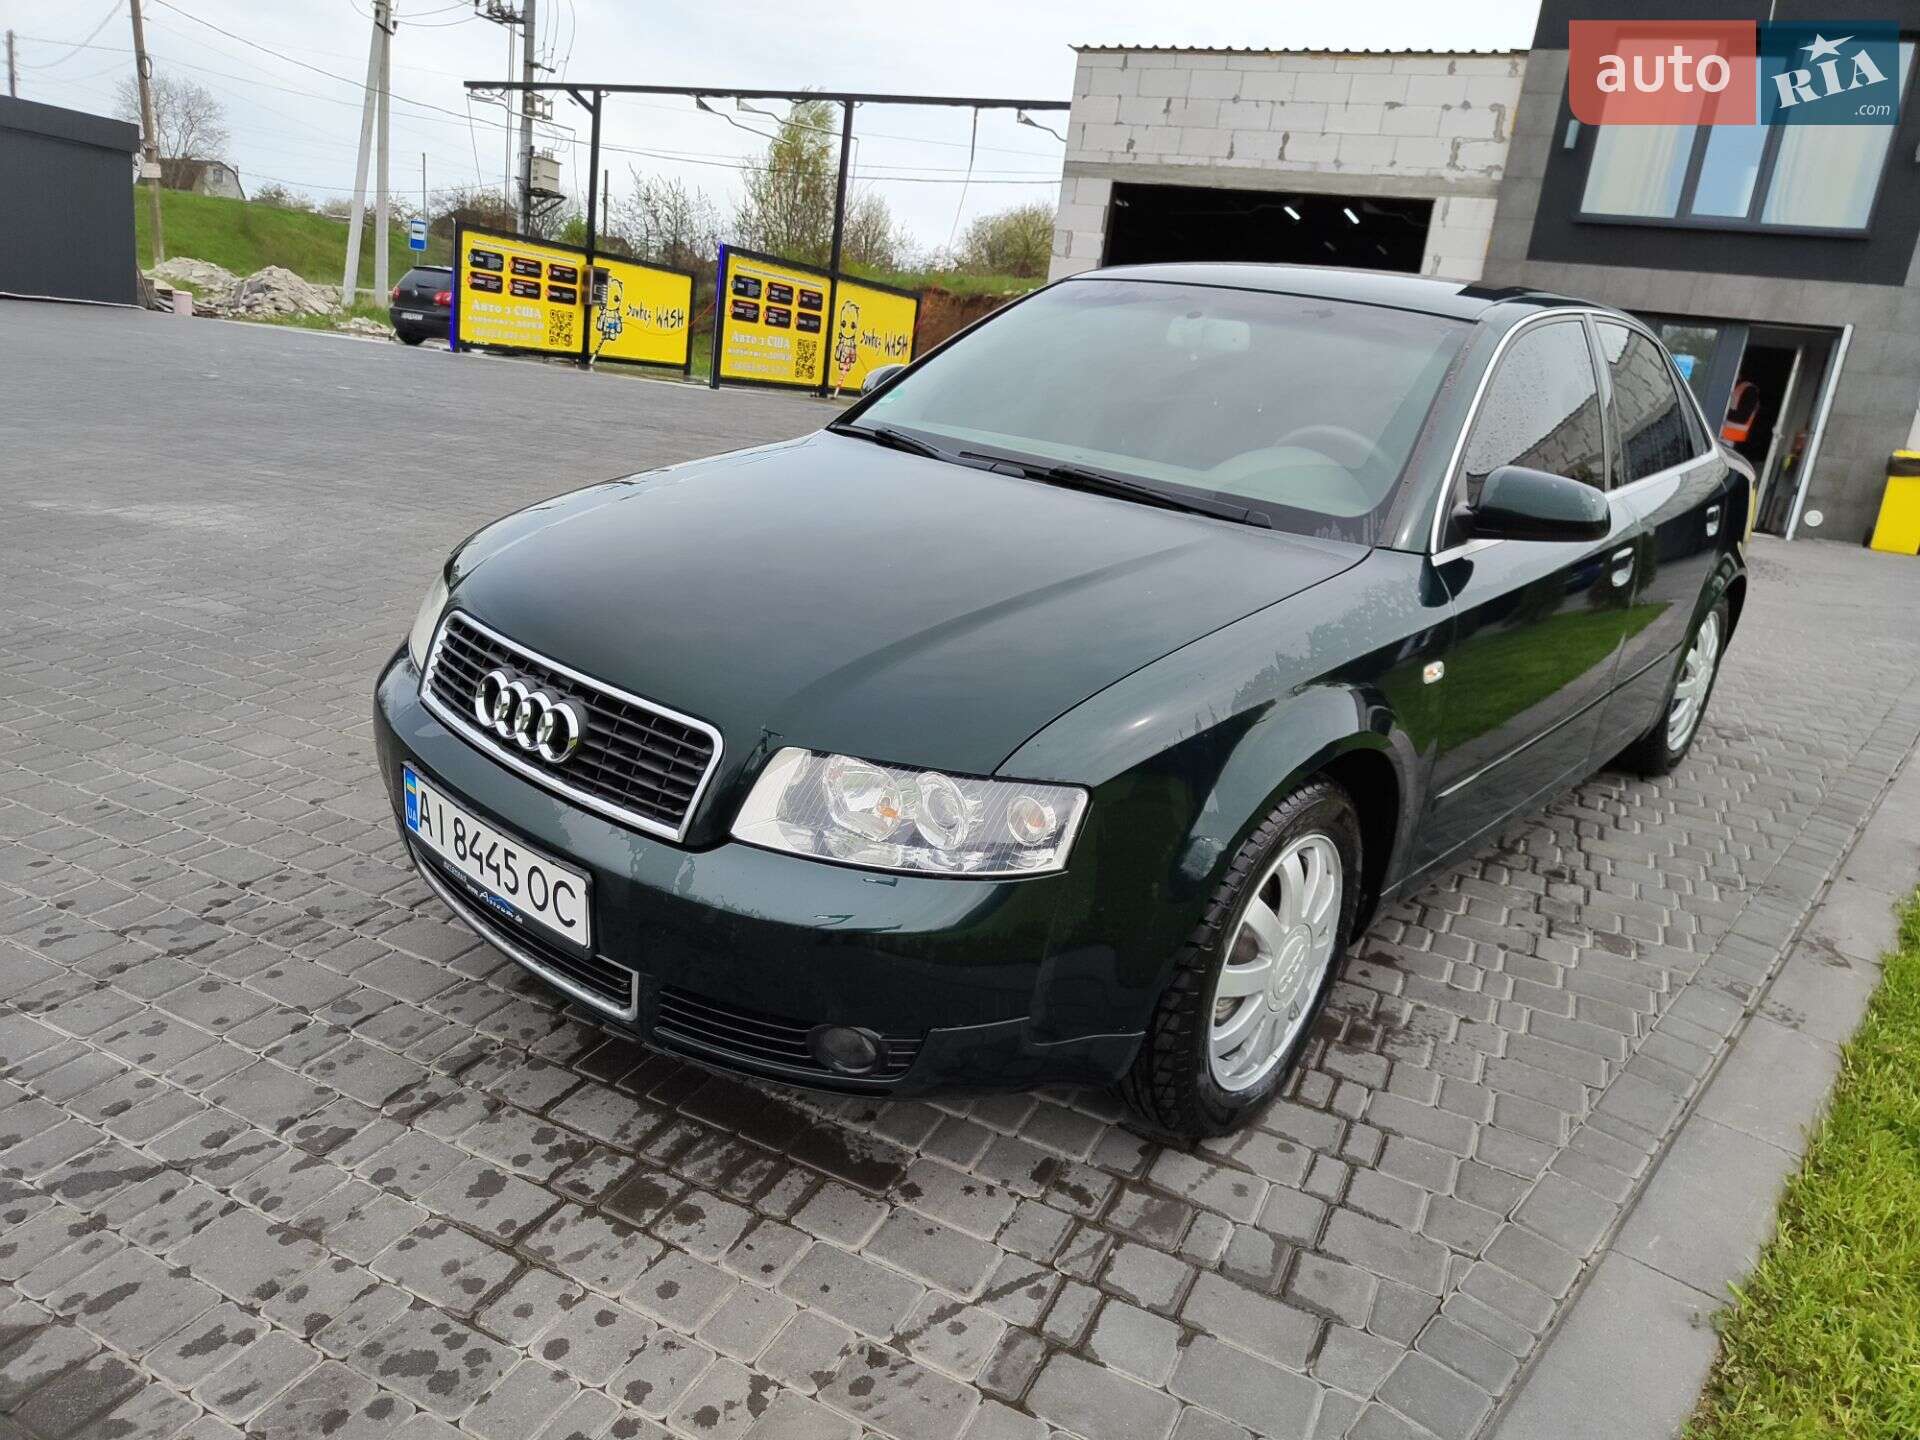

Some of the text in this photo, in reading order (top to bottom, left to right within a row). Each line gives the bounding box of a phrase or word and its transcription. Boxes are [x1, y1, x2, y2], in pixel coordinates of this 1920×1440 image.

[472, 298, 502, 314] Авто
[514, 305, 542, 320] США
[656, 306, 684, 329] WASH
[731, 331, 757, 345] Авто
[884, 330, 908, 356] WASH
[407, 807, 417, 823] UA
[419, 790, 576, 928] AI 8445 OC
